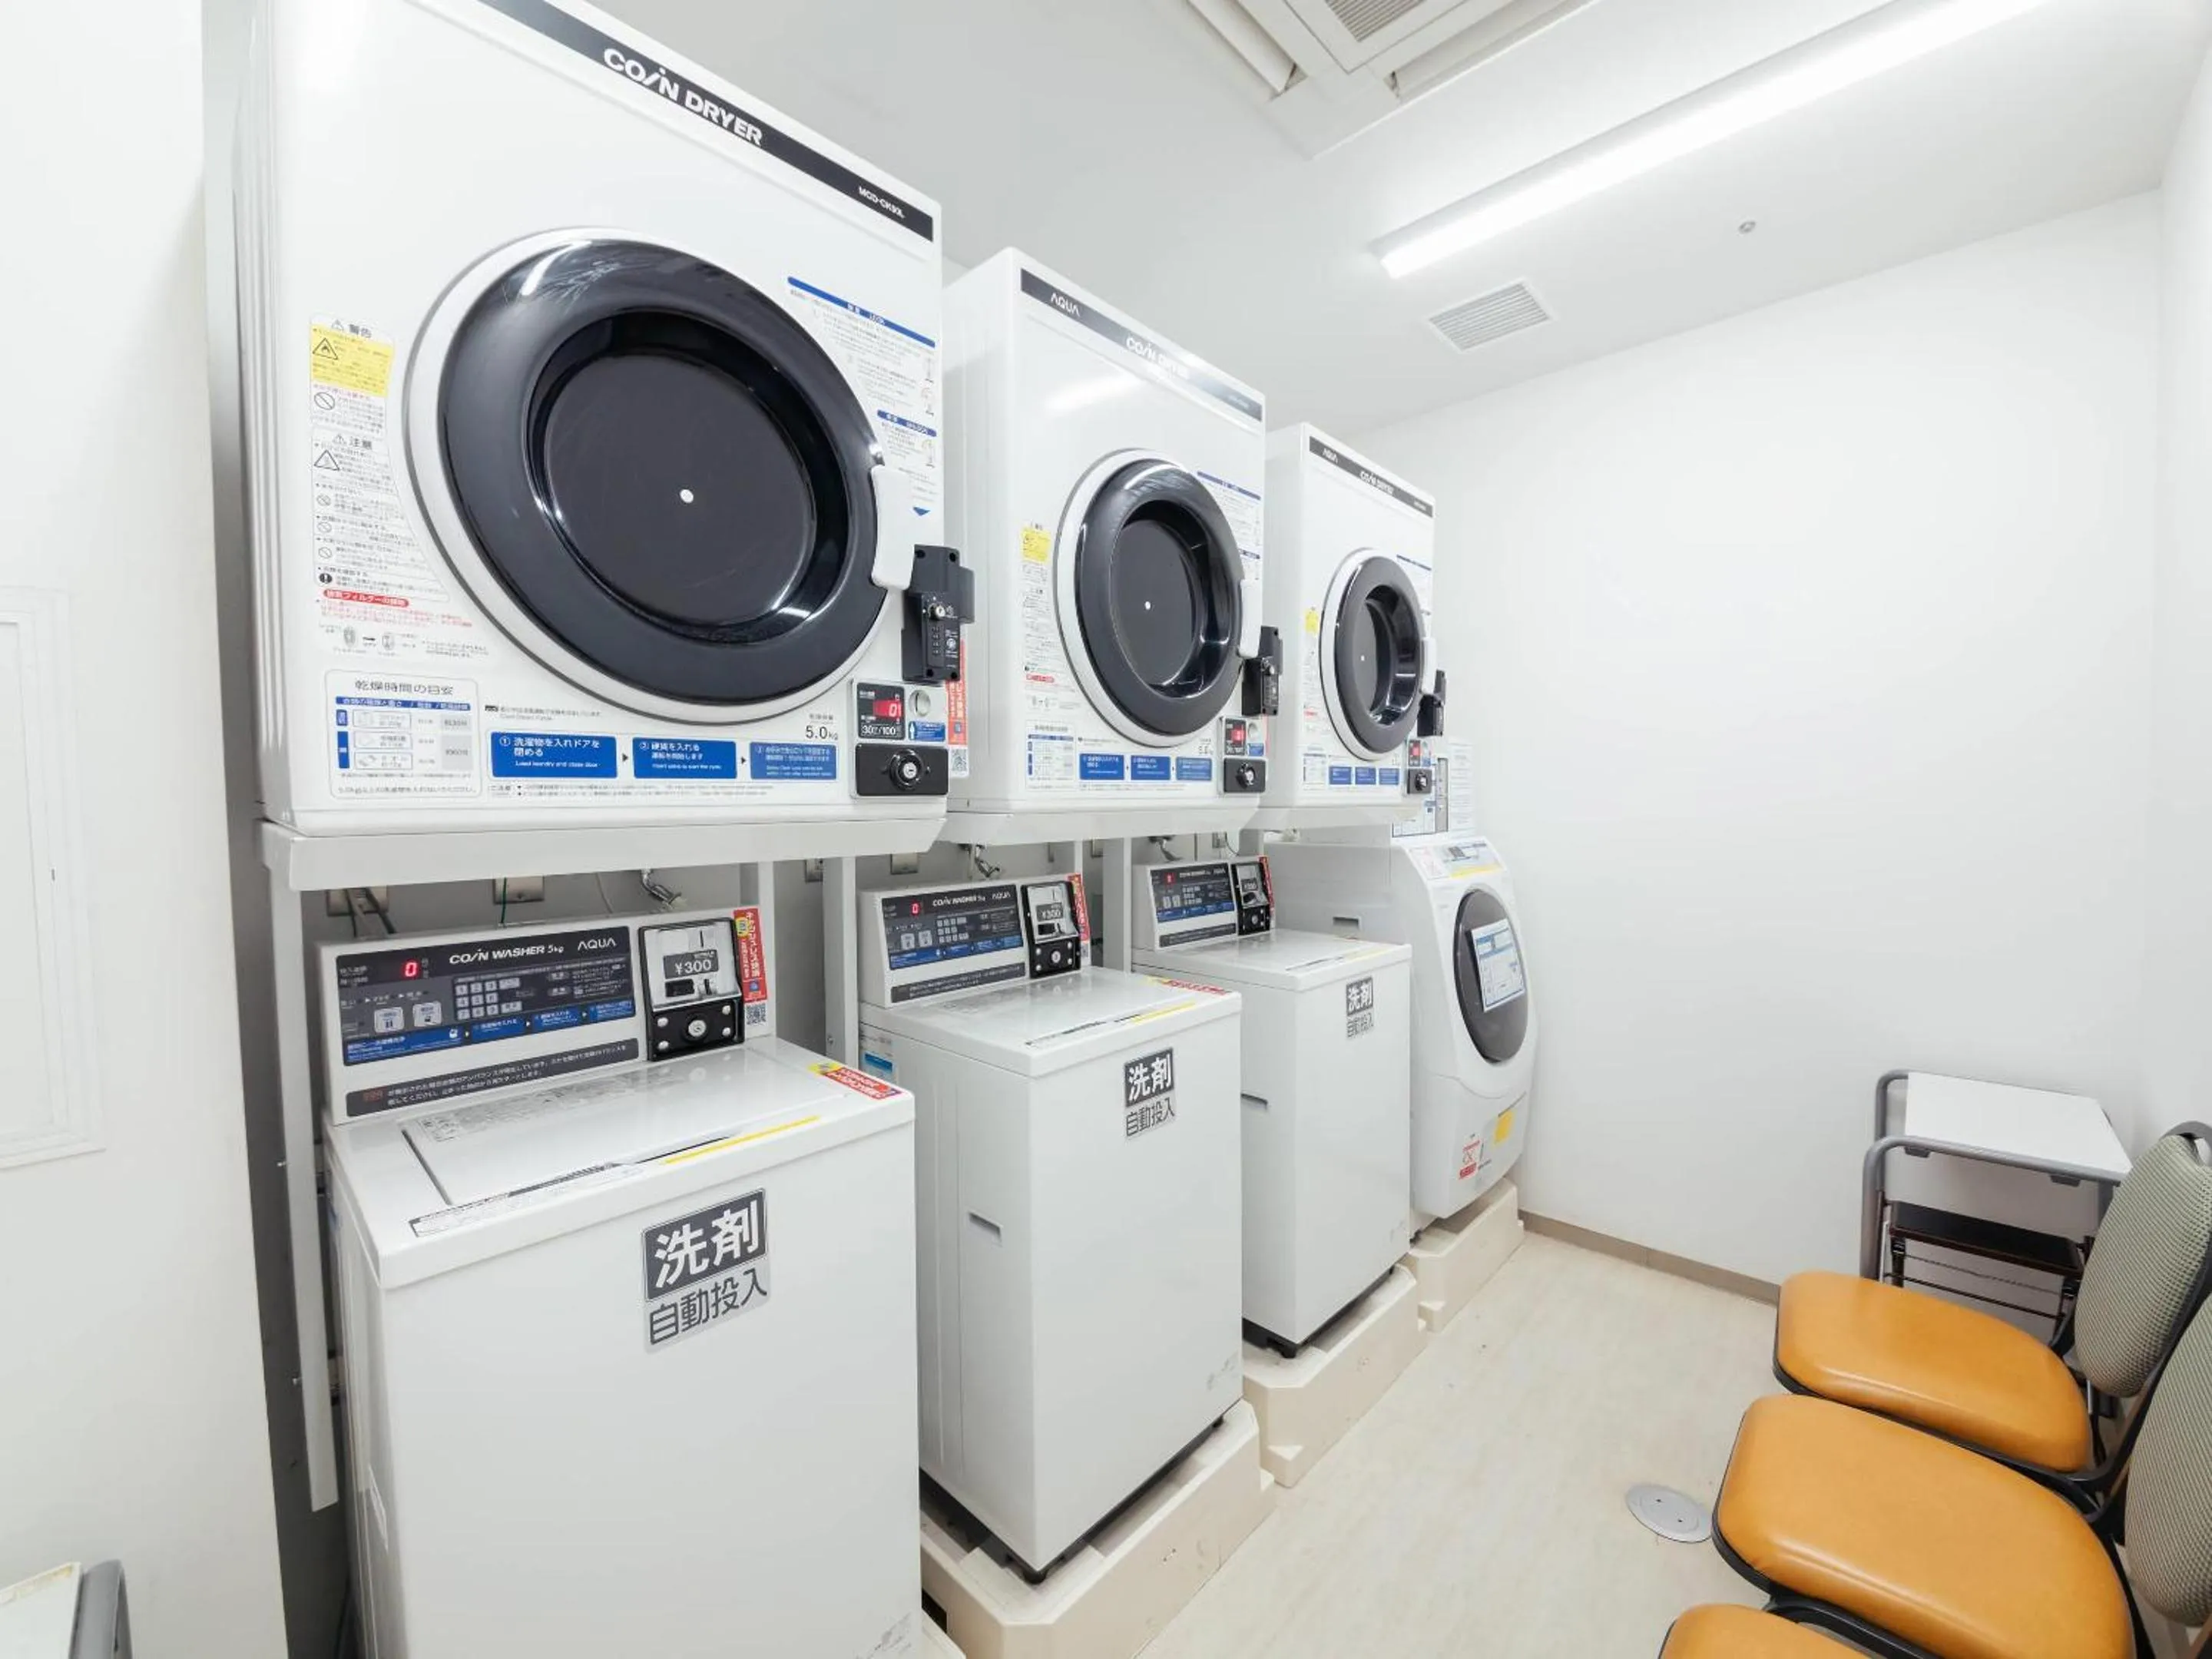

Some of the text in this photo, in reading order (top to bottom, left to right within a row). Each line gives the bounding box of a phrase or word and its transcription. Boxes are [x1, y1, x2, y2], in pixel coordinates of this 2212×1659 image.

[603, 48, 763, 147] COIN DRYER
[1050, 293, 1081, 317] AQUA
[932, 896, 952, 907] COIN
[449, 948, 489, 965] COIN
[492, 945, 546, 960] WASHER
[577, 937, 617, 952] AQUA
[403, 961, 419, 979] 0
[674, 959, 713, 976] ¥300
[1348, 984, 1373, 1012] 洗剤
[1128, 1051, 1173, 1101] 洗剤
[1125, 1096, 1176, 1137] 自動投入
[654, 1198, 760, 1289] 洗剤
[649, 1268, 768, 1346] 自動投入
